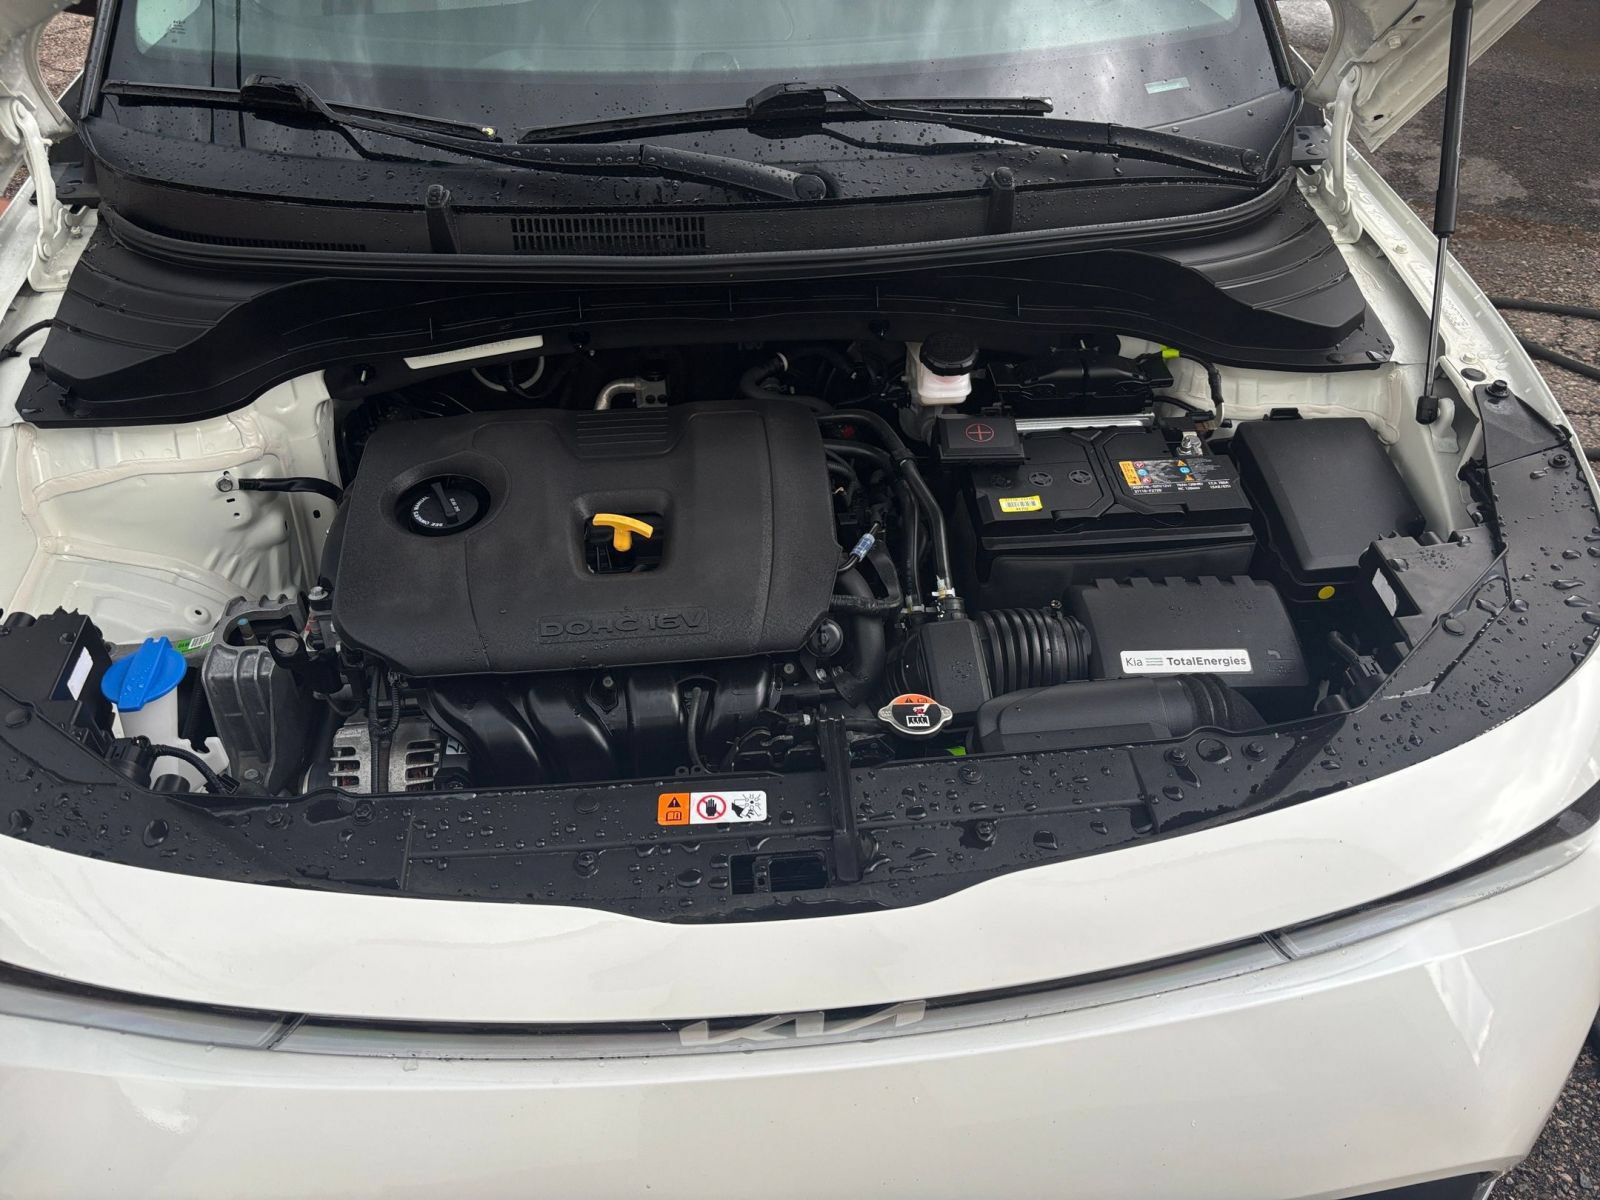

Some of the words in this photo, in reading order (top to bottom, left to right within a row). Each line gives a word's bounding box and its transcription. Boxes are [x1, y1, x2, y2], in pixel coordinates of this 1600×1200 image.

[541, 615, 639, 637] DOHC
[648, 612, 705, 631] 16V
[1125, 657, 1143, 667] Kia
[1166, 656, 1247, 667] TotalEnergies
